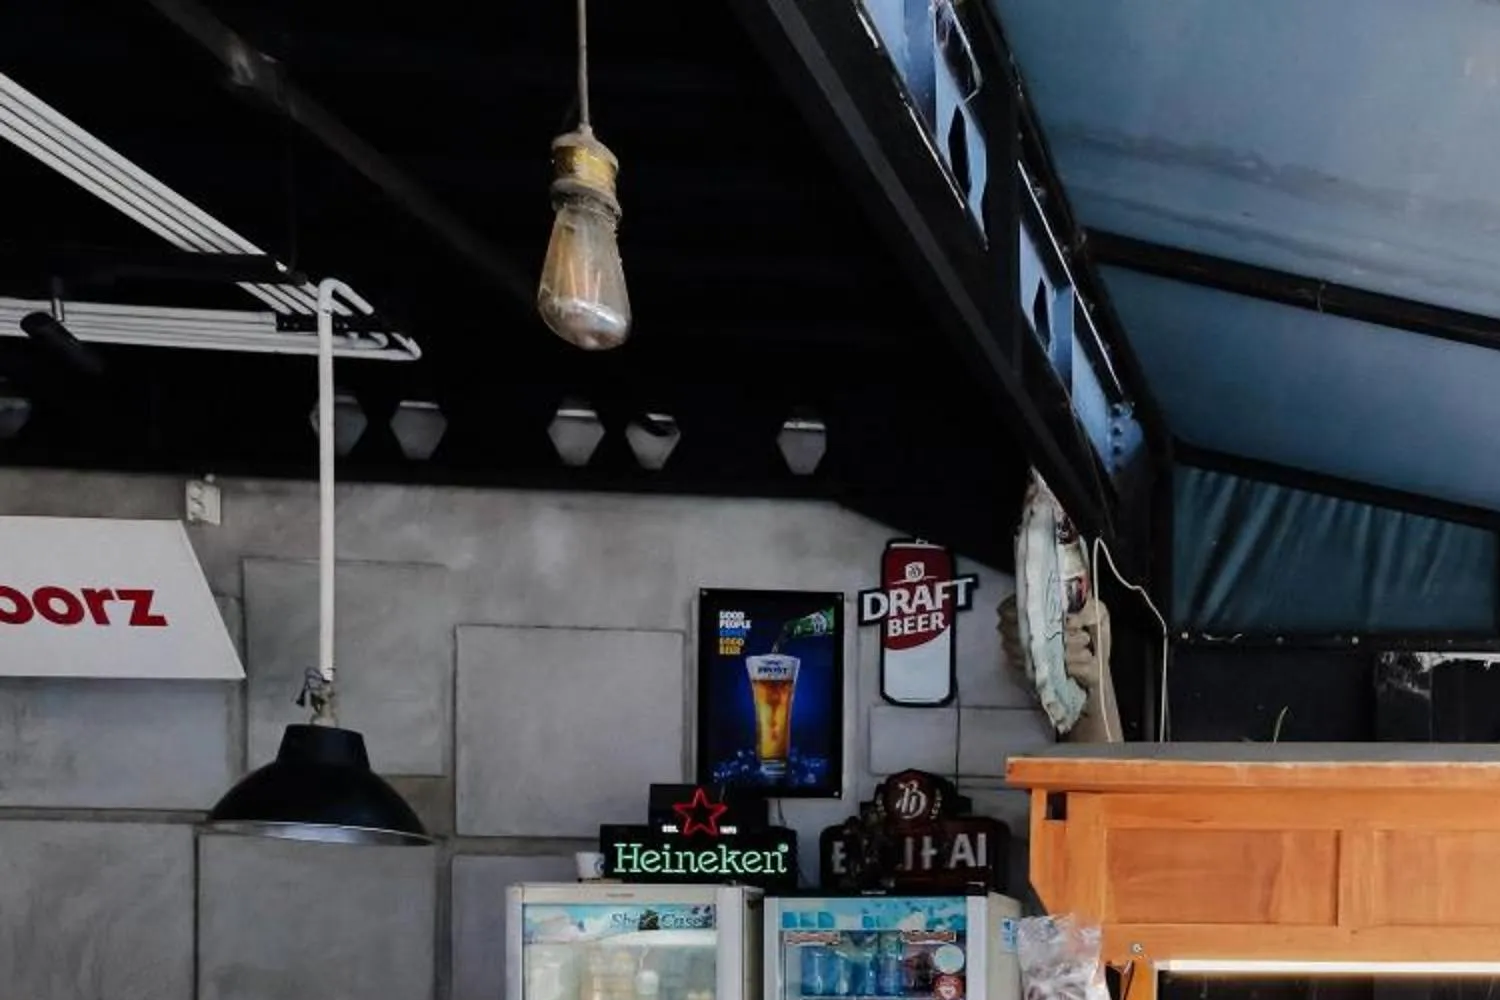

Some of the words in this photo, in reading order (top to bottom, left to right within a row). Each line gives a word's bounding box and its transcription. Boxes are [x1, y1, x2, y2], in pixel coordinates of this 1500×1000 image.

[0, 585, 168, 626] oorz
[863, 577, 973, 621] DRAFT
[887, 611, 945, 637] BEER
[613, 843, 788, 874] Heineken
